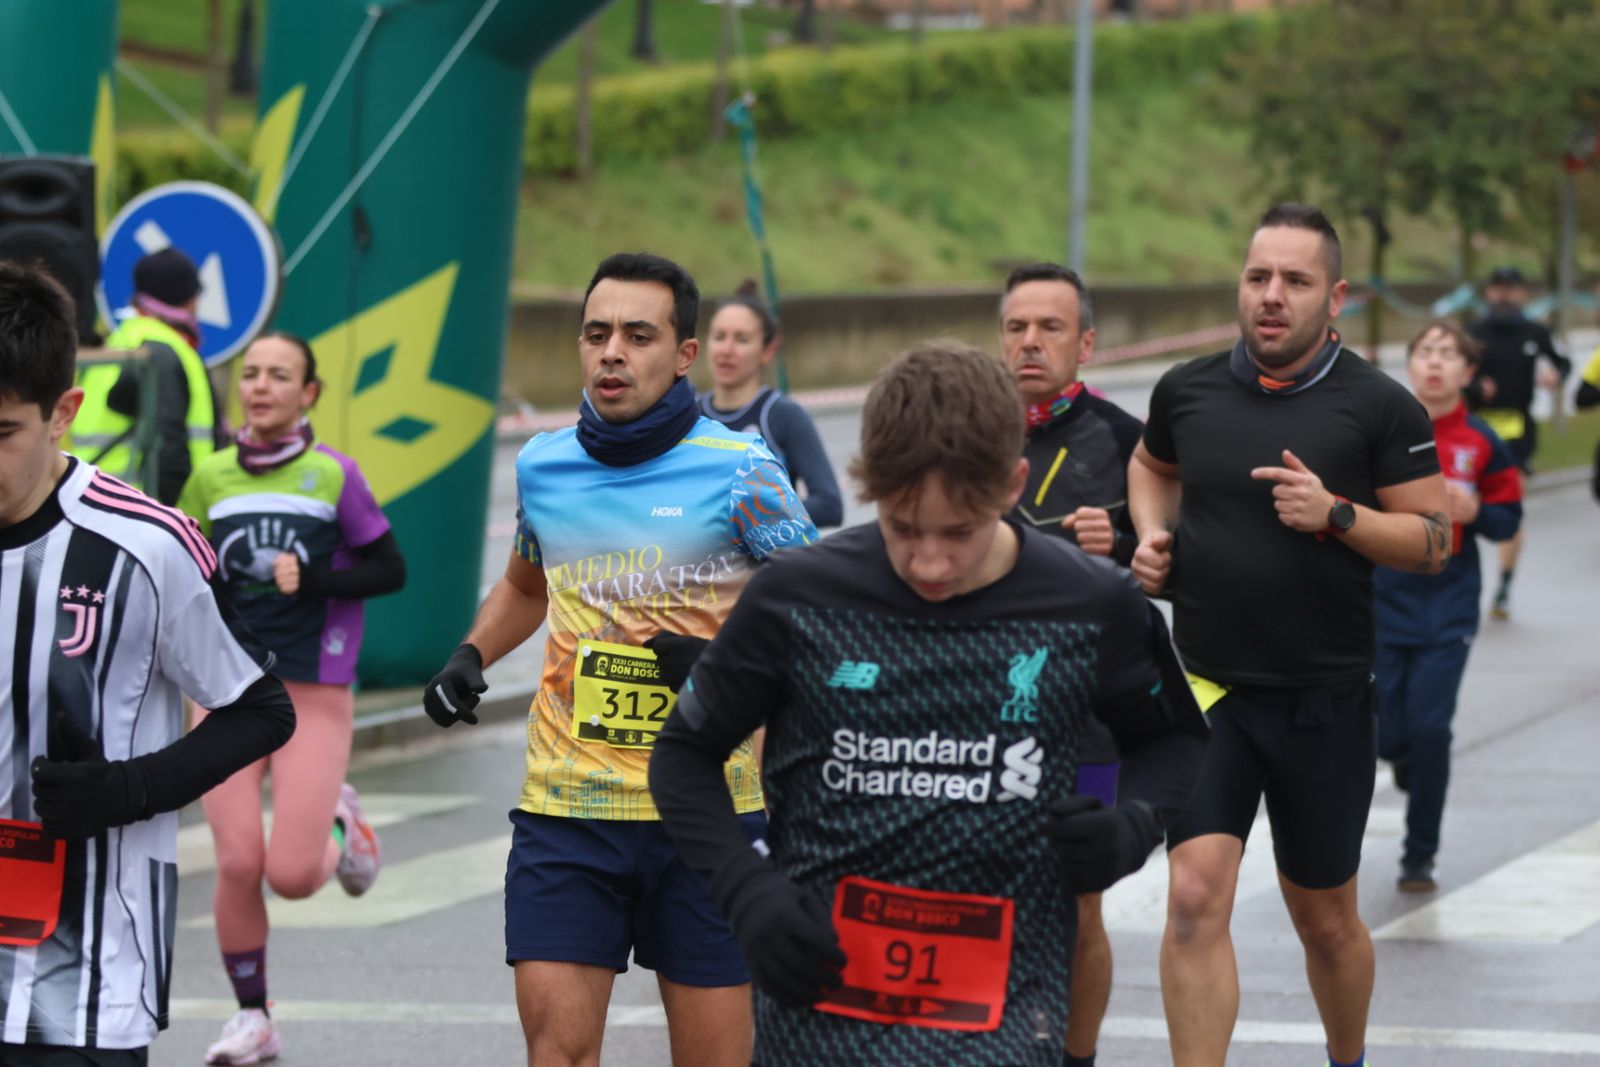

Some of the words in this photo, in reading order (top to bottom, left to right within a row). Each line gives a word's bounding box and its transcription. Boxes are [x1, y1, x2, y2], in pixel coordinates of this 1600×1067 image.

[651, 506, 683, 517] HOKA
[561, 543, 664, 586] MEDIO
[581, 551, 736, 607] MARATÓN
[610, 664, 631, 677] DON
[632, 668, 660, 679] BOSC
[627, 660, 656, 670] CARRERA
[602, 687, 669, 722] 312
[1000, 700, 1039, 723] LFC
[832, 728, 997, 767] Standard
[821, 758, 993, 804] Chartered
[884, 939, 943, 986] 91
